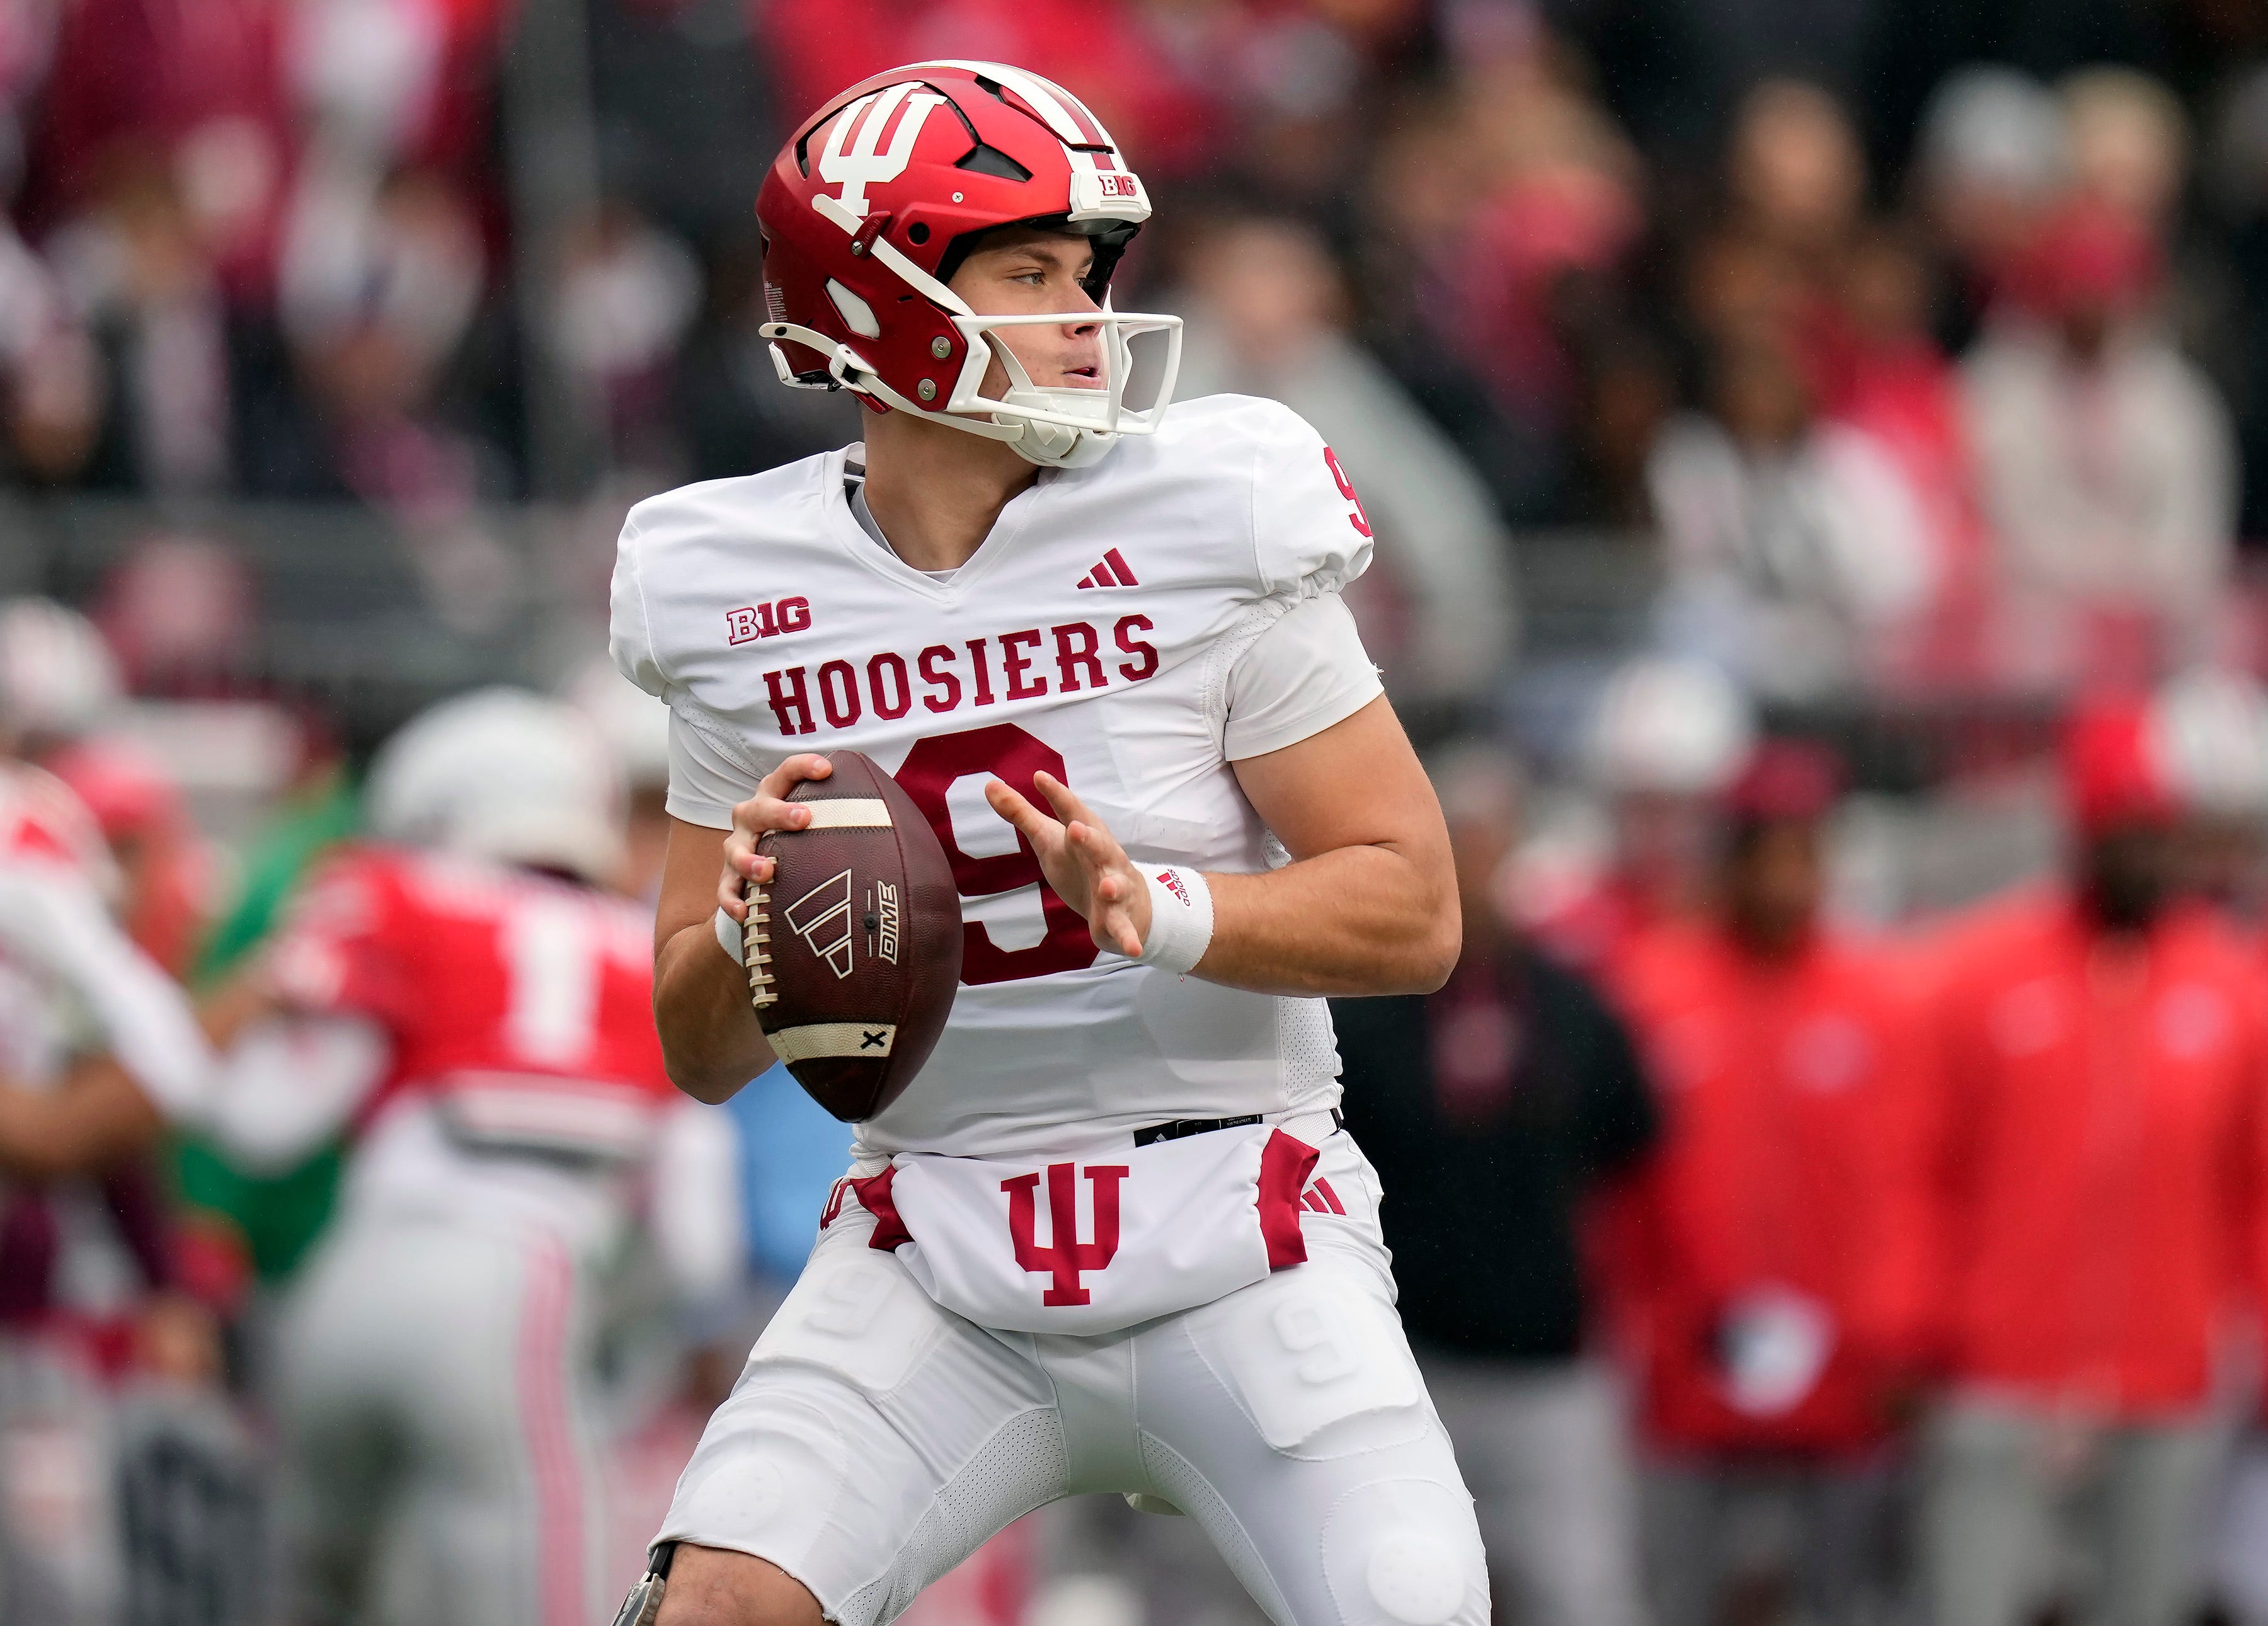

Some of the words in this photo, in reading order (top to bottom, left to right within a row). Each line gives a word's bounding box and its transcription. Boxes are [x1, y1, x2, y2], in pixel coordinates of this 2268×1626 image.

[763, 614, 1159, 736] HOOSIERS
[893, 723, 1102, 986] 9
[1167, 869, 1191, 907] adidas
[878, 879, 898, 965] DIME
